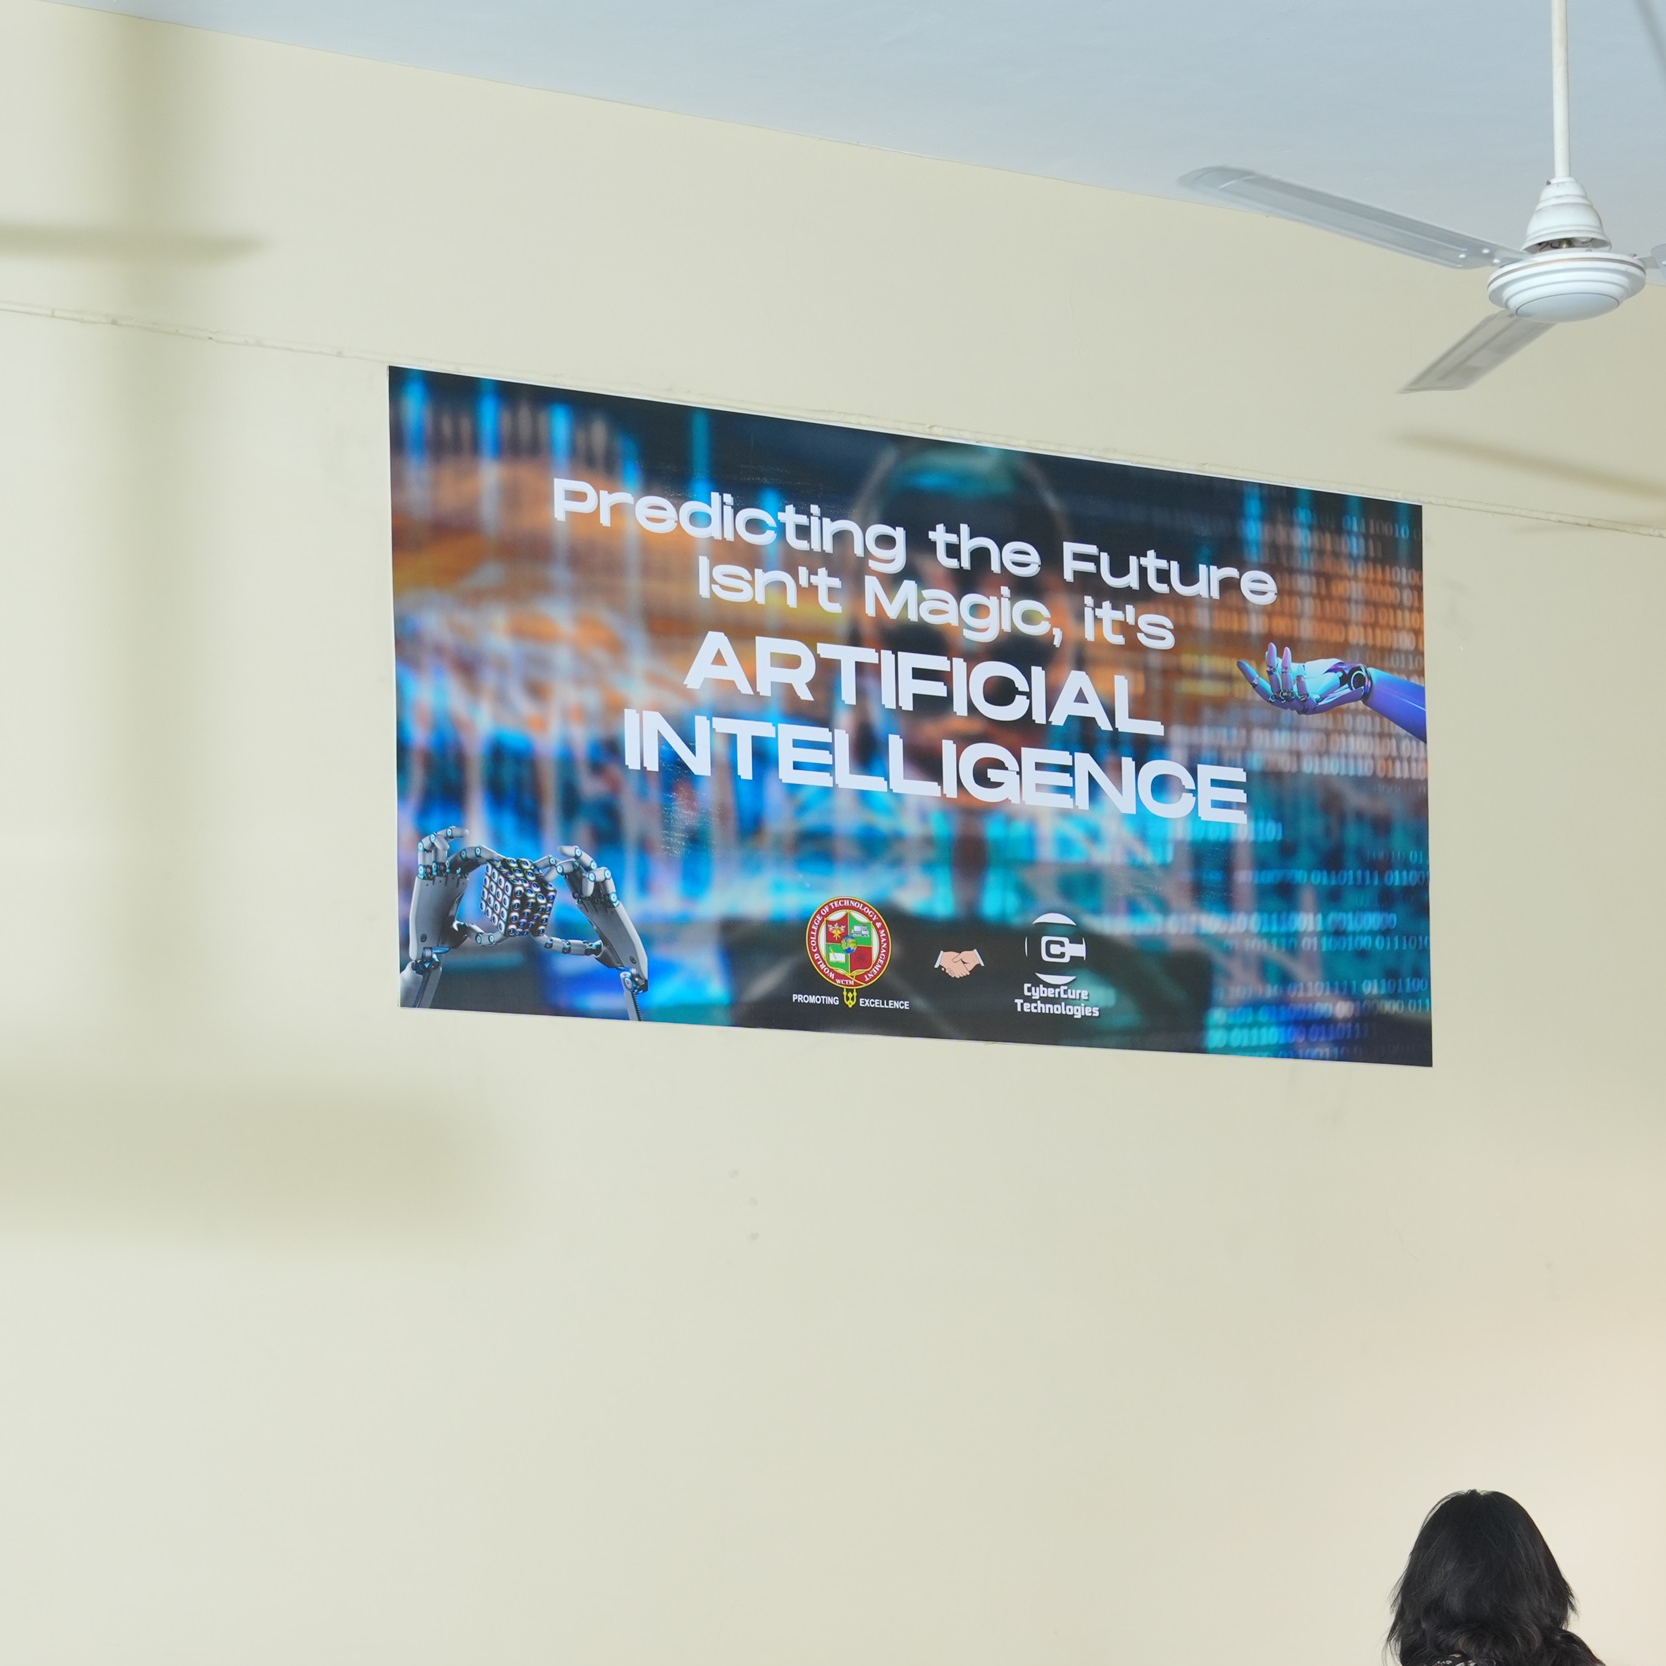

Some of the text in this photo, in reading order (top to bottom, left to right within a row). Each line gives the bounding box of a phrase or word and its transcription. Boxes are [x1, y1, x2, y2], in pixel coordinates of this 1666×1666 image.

[553, 477, 1279, 606] Predicting the Future
[697, 555, 842, 615] Isn't
[864, 575, 1064, 648] Magic,
[1082, 596, 1176, 651] it's
[683, 630, 1166, 737] ARTIFICIAL
[623, 707, 1248, 825] INTELLIGENCE
[819, 905, 830, 917] OF
[829, 899, 879, 923] TECHNOLOGY
[810, 915, 823, 951] COLLEGE
[813, 951, 836, 979] WORLD
[865, 928, 890, 982] MANAGEMENT
[792, 993, 910, 1010] PROMOTING EXCELLENCE
[1023, 983, 1089, 1000] CyberCure
[1014, 999, 1100, 1019] Technologies
